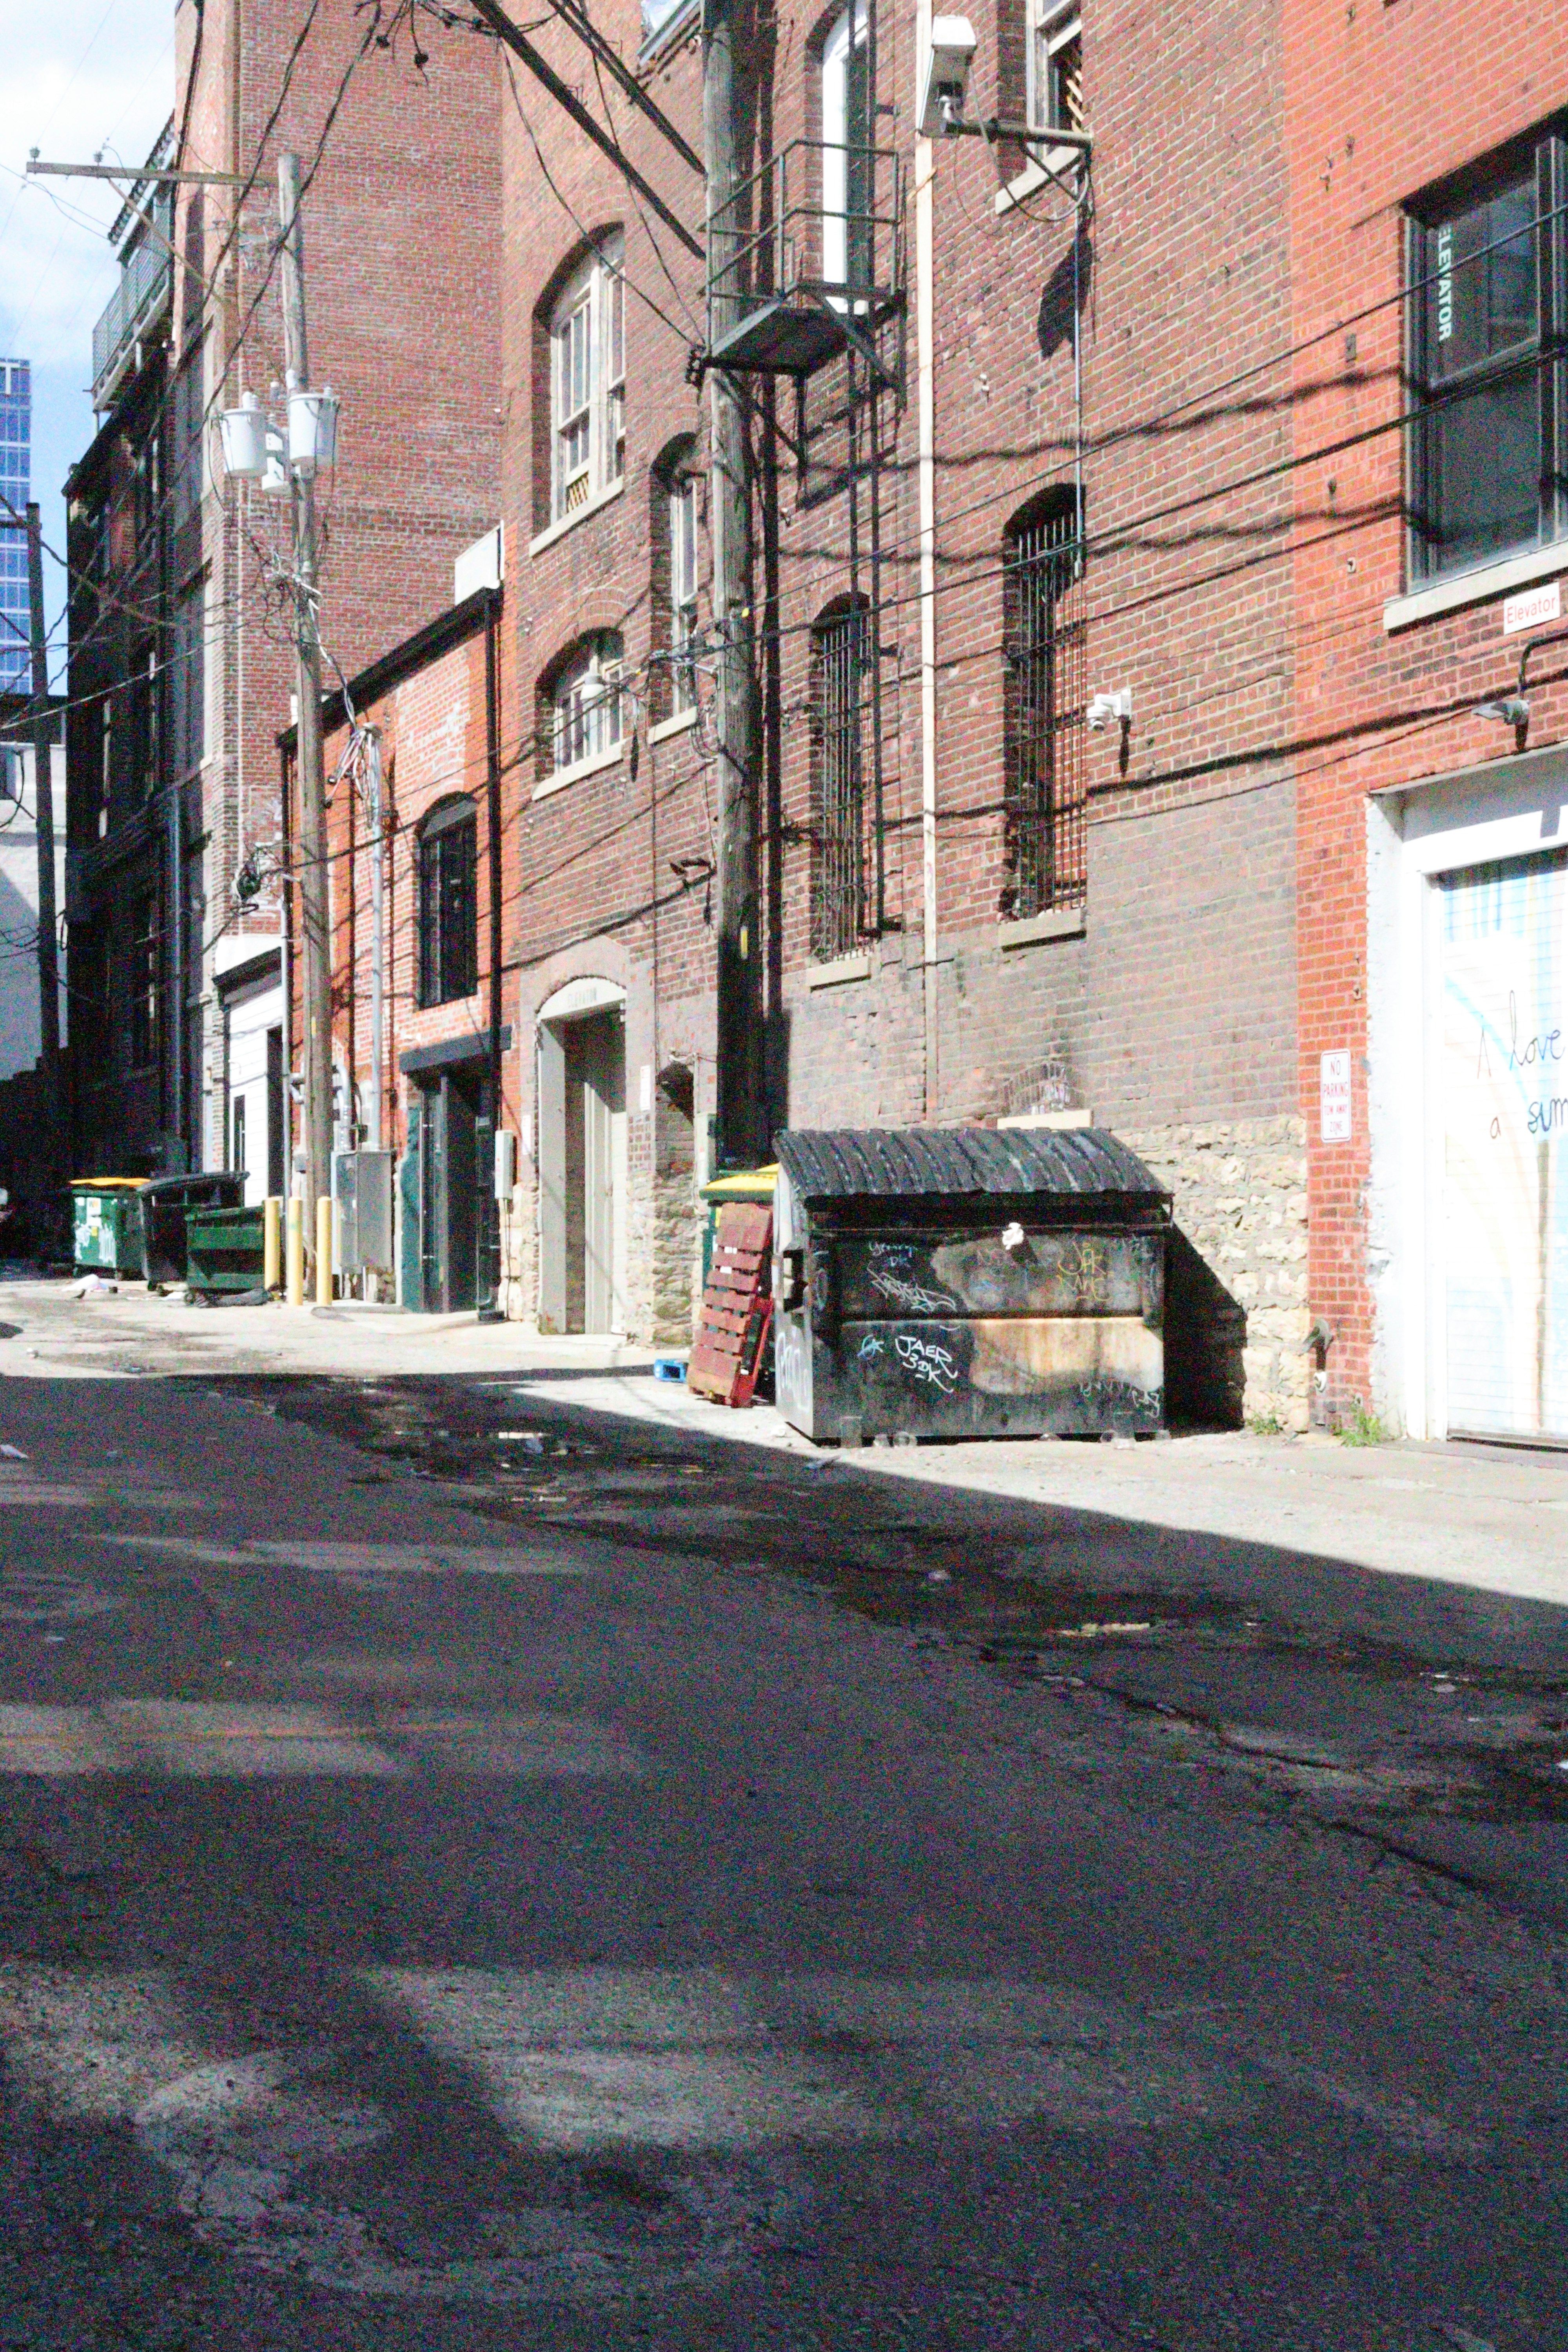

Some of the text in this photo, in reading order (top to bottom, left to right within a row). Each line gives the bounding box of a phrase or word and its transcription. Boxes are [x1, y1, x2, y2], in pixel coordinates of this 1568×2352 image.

[1438, 225, 1452, 341] ELEVATOR
[1506, 597, 1555, 624] Elevator
[1509, 989, 1566, 1071] love
[1330, 1060, 1341, 1076] NO
[1323, 1082, 1348, 1098] PARKING
[1324, 1104, 1348, 1116] TOW AWAY
[1330, 1121, 1343, 1132] ZONE
[1490, 1115, 1502, 1139] a
[895, 1335, 959, 1379] JAER
